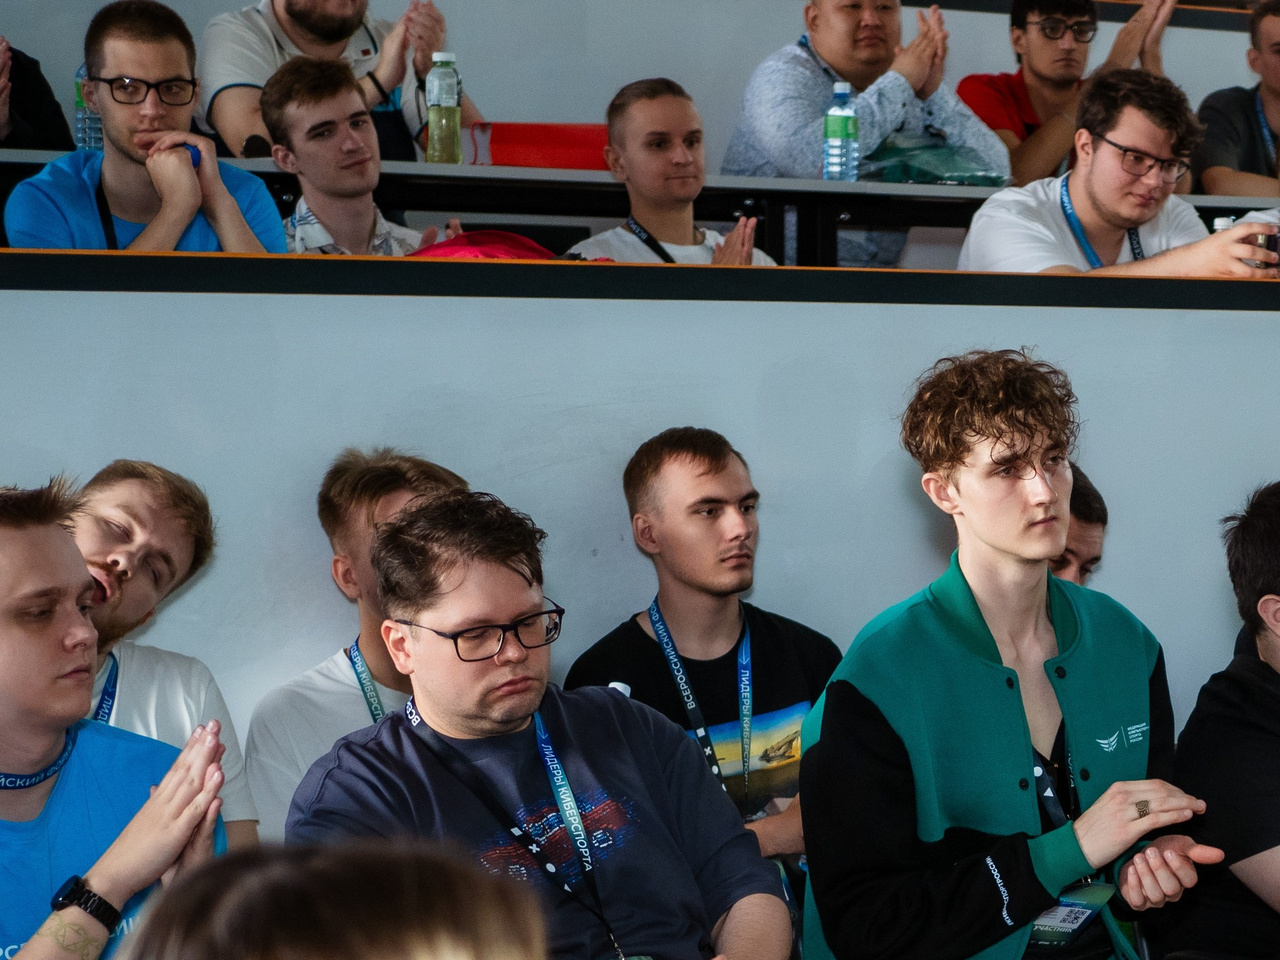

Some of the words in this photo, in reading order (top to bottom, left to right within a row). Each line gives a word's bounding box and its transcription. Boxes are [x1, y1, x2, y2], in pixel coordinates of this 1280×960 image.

[350, 643, 365, 672] ДЕРЫ
[655, 622, 696, 710] ВСЕРОССИЙСКИЙ
[740, 669, 750, 715] ЛИДЕРЫ
[541, 743, 566, 786] ЛИДЕРЫ
[557, 785, 593, 872] КИБЕРСПОРТА
[1033, 925, 1073, 933] УЧАСТНИК
